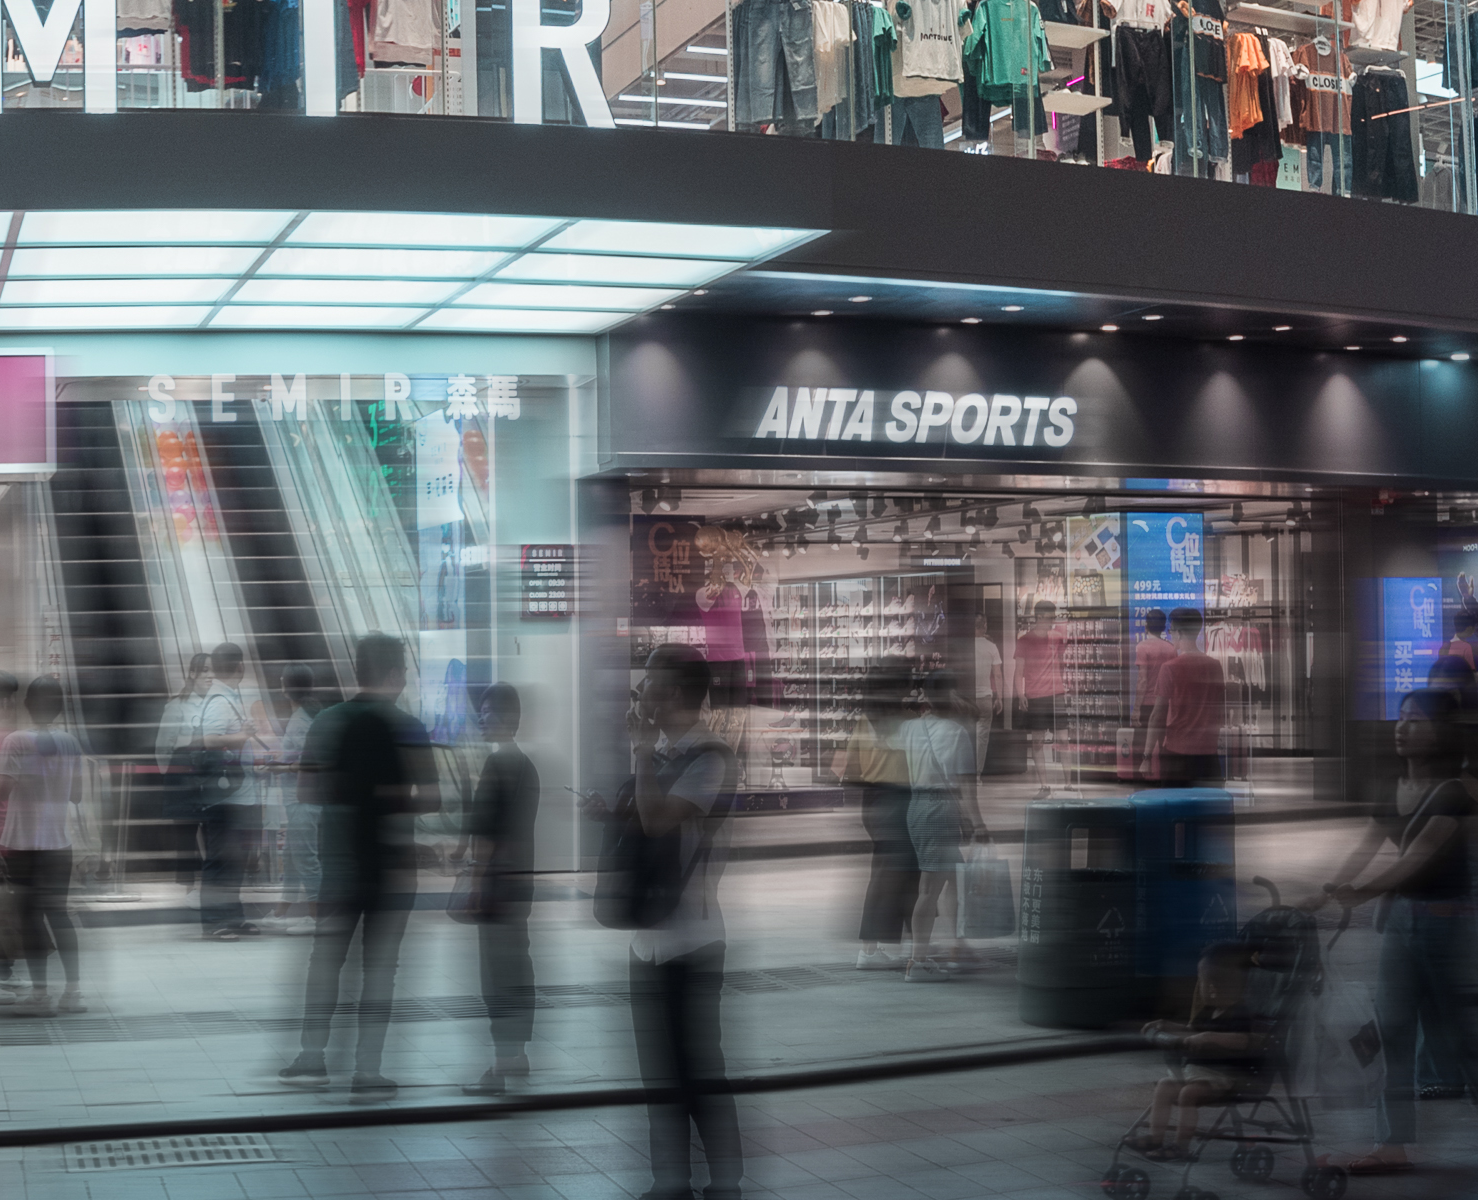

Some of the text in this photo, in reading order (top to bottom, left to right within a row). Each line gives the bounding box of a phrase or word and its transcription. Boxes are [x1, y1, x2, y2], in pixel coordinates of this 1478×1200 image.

[148, 372, 520, 422] SEMIR 森馬
[755, 386, 1078, 448] ANTA SPORTS
[1133, 580, 1162, 592] 499元
